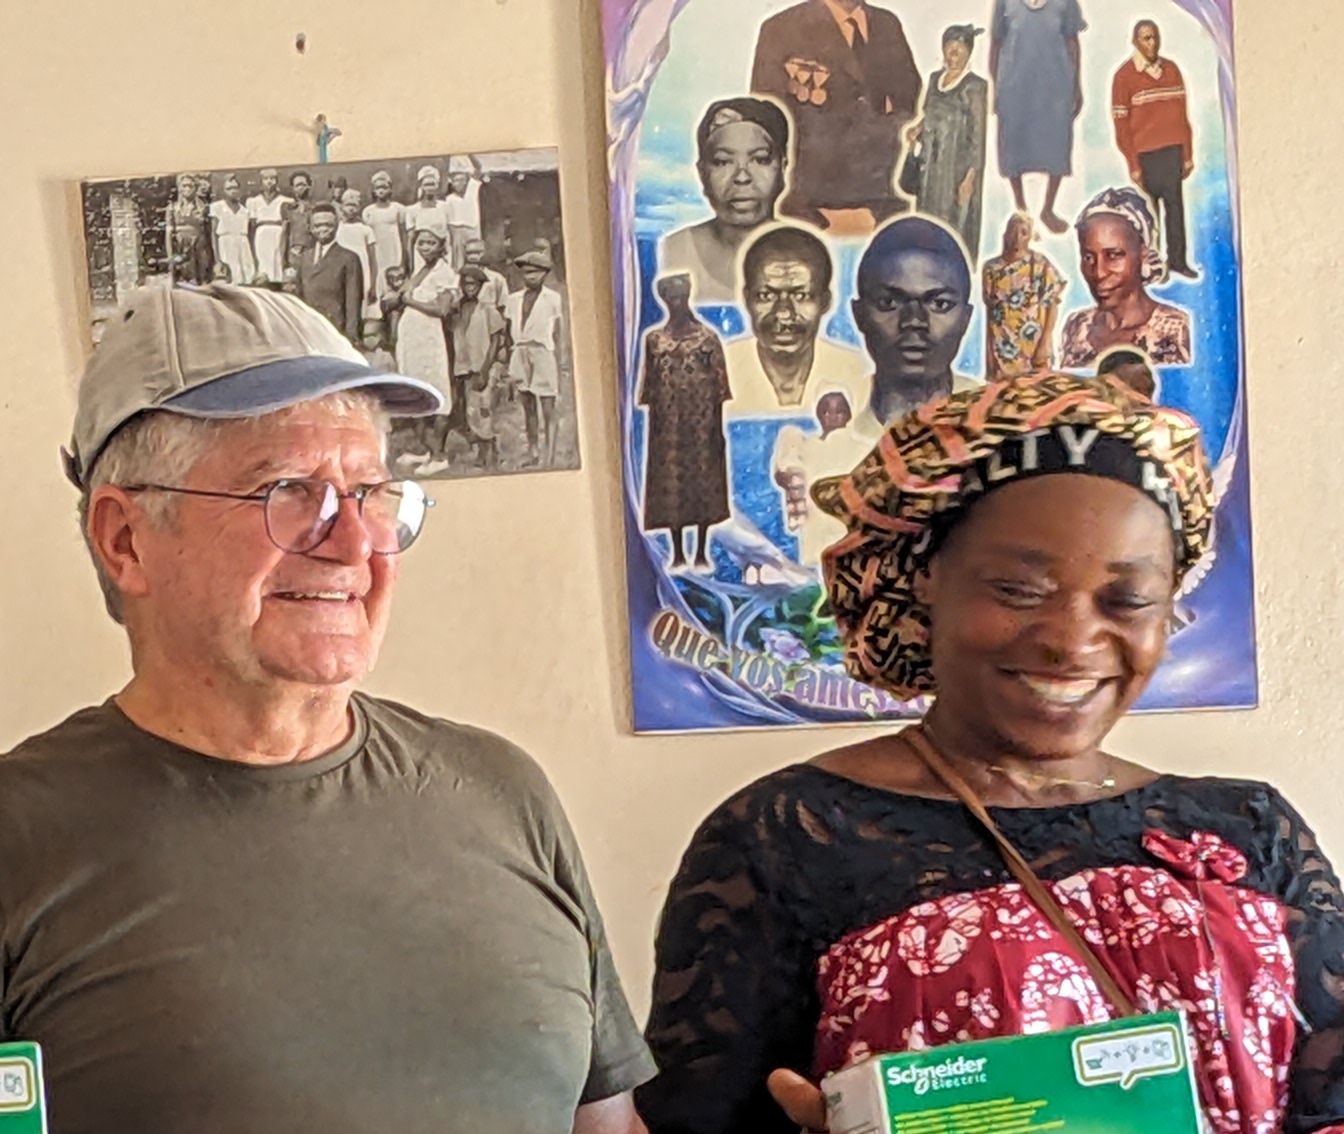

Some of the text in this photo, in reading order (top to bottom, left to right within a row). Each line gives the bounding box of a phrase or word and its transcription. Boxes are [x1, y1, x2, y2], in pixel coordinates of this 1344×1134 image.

[653, 611, 719, 669] Que
[887, 1056, 987, 1086] Schneider
[931, 1073, 987, 1091] Electric
